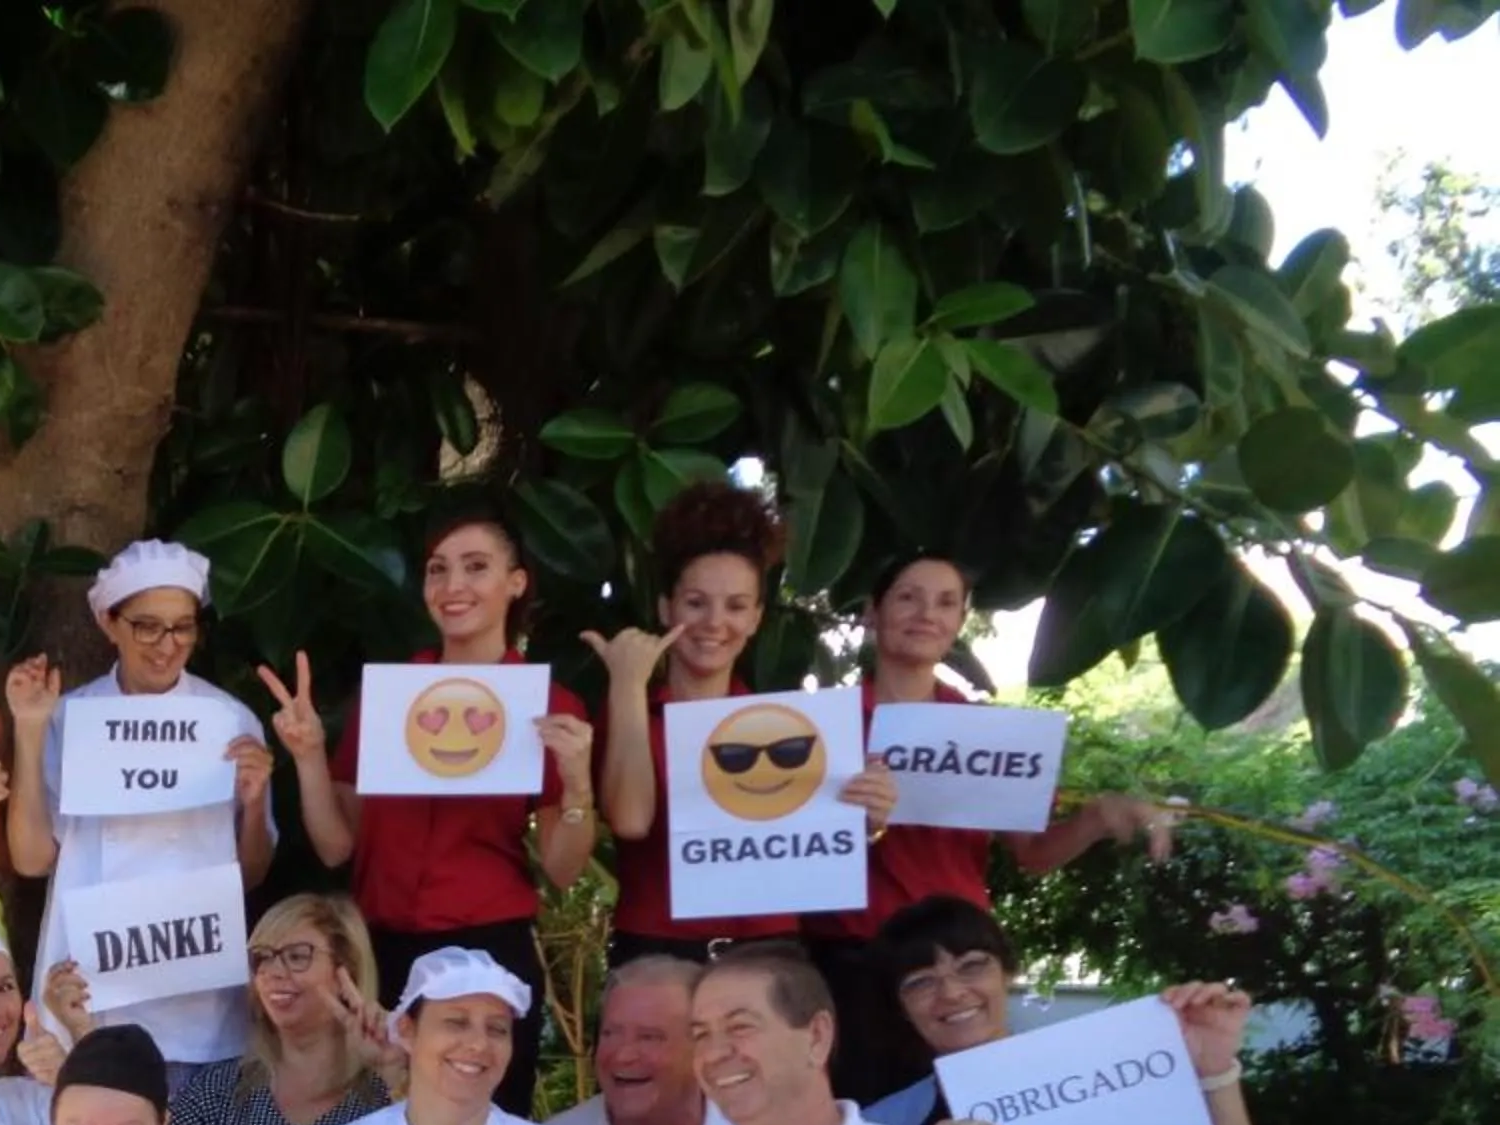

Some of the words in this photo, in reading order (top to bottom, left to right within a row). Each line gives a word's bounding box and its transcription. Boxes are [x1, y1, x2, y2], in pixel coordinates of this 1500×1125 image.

[105, 719, 199, 742] THANK
[884, 741, 1043, 779] GRÀCIES
[121, 768, 179, 790] YOU
[681, 830, 855, 865] GRACIAS
[93, 912, 224, 974] DANKE
[968, 1049, 1176, 1124] OBRIGADO
